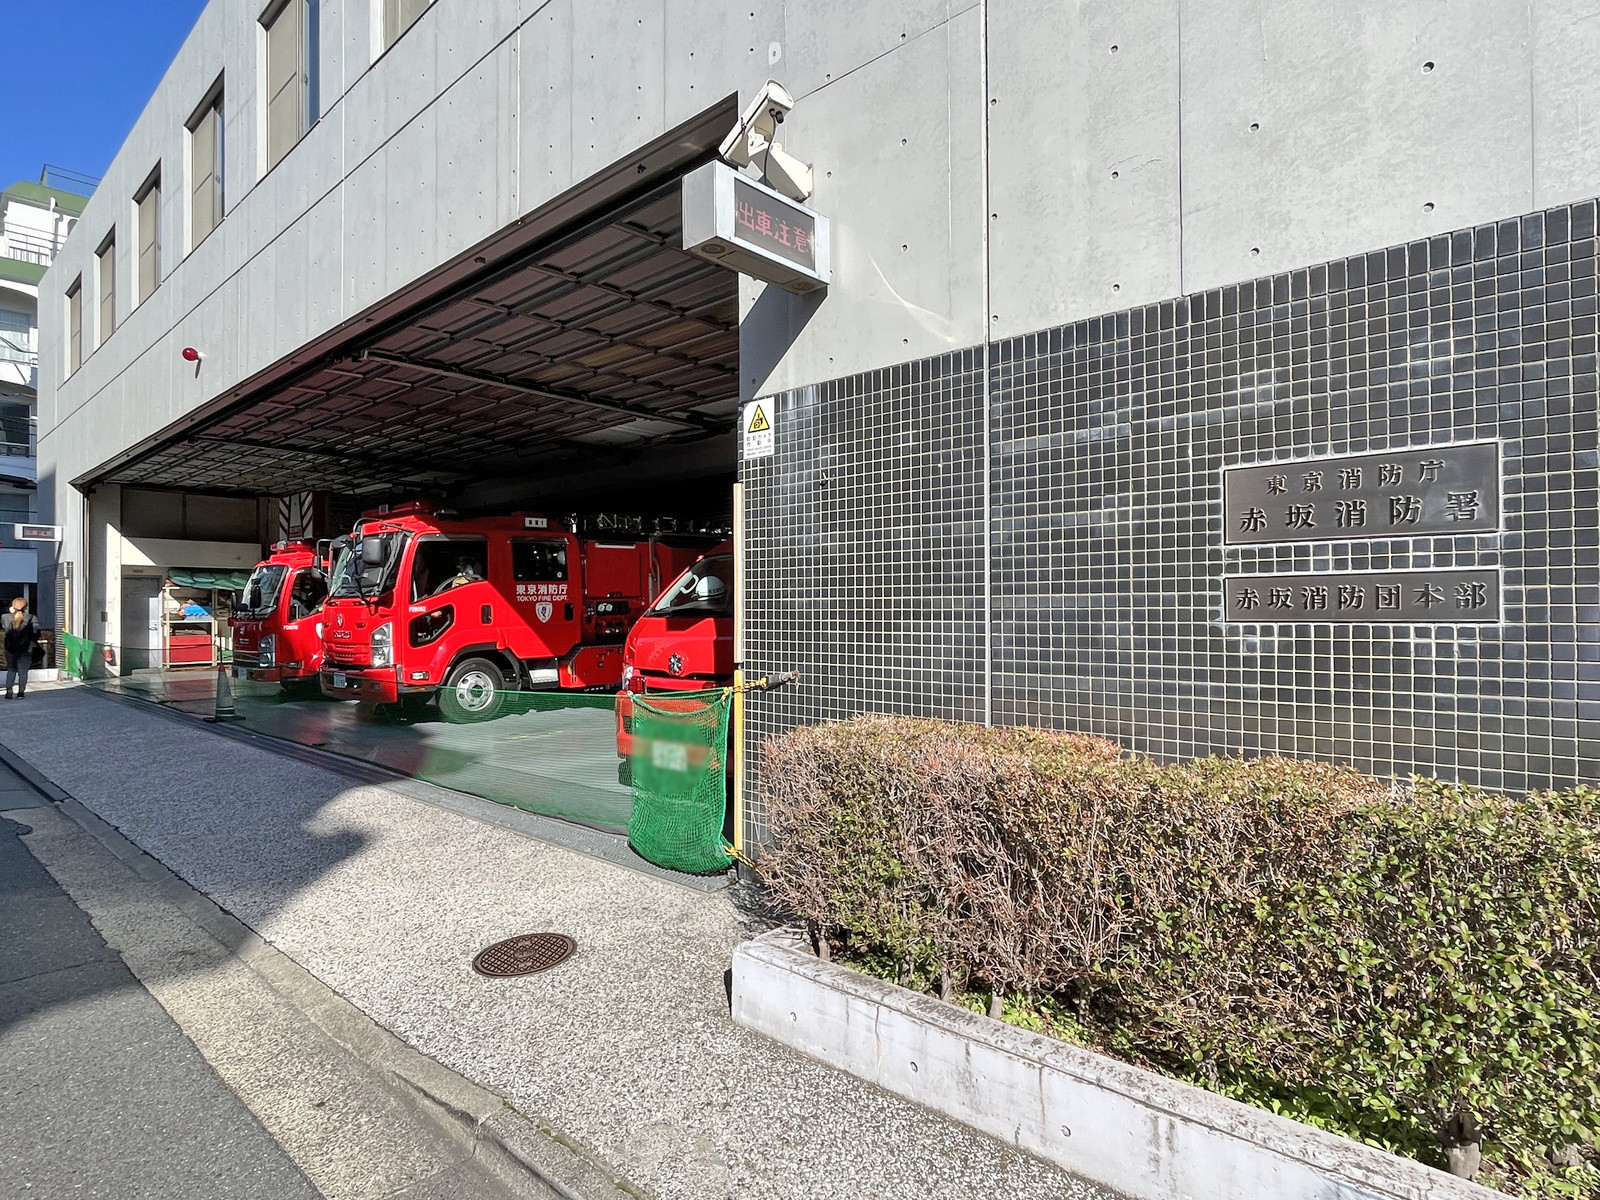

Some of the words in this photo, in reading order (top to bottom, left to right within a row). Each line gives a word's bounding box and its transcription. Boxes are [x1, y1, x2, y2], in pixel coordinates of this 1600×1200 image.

[737, 200, 809, 254] 出車注意
[1265, 459, 1446, 497] 東京消防庁
[1238, 490, 1480, 534] 赤坂消防署
[516, 584, 568, 595] 東京消防庁
[1234, 581, 1488, 611] 赤坂消防団本部
